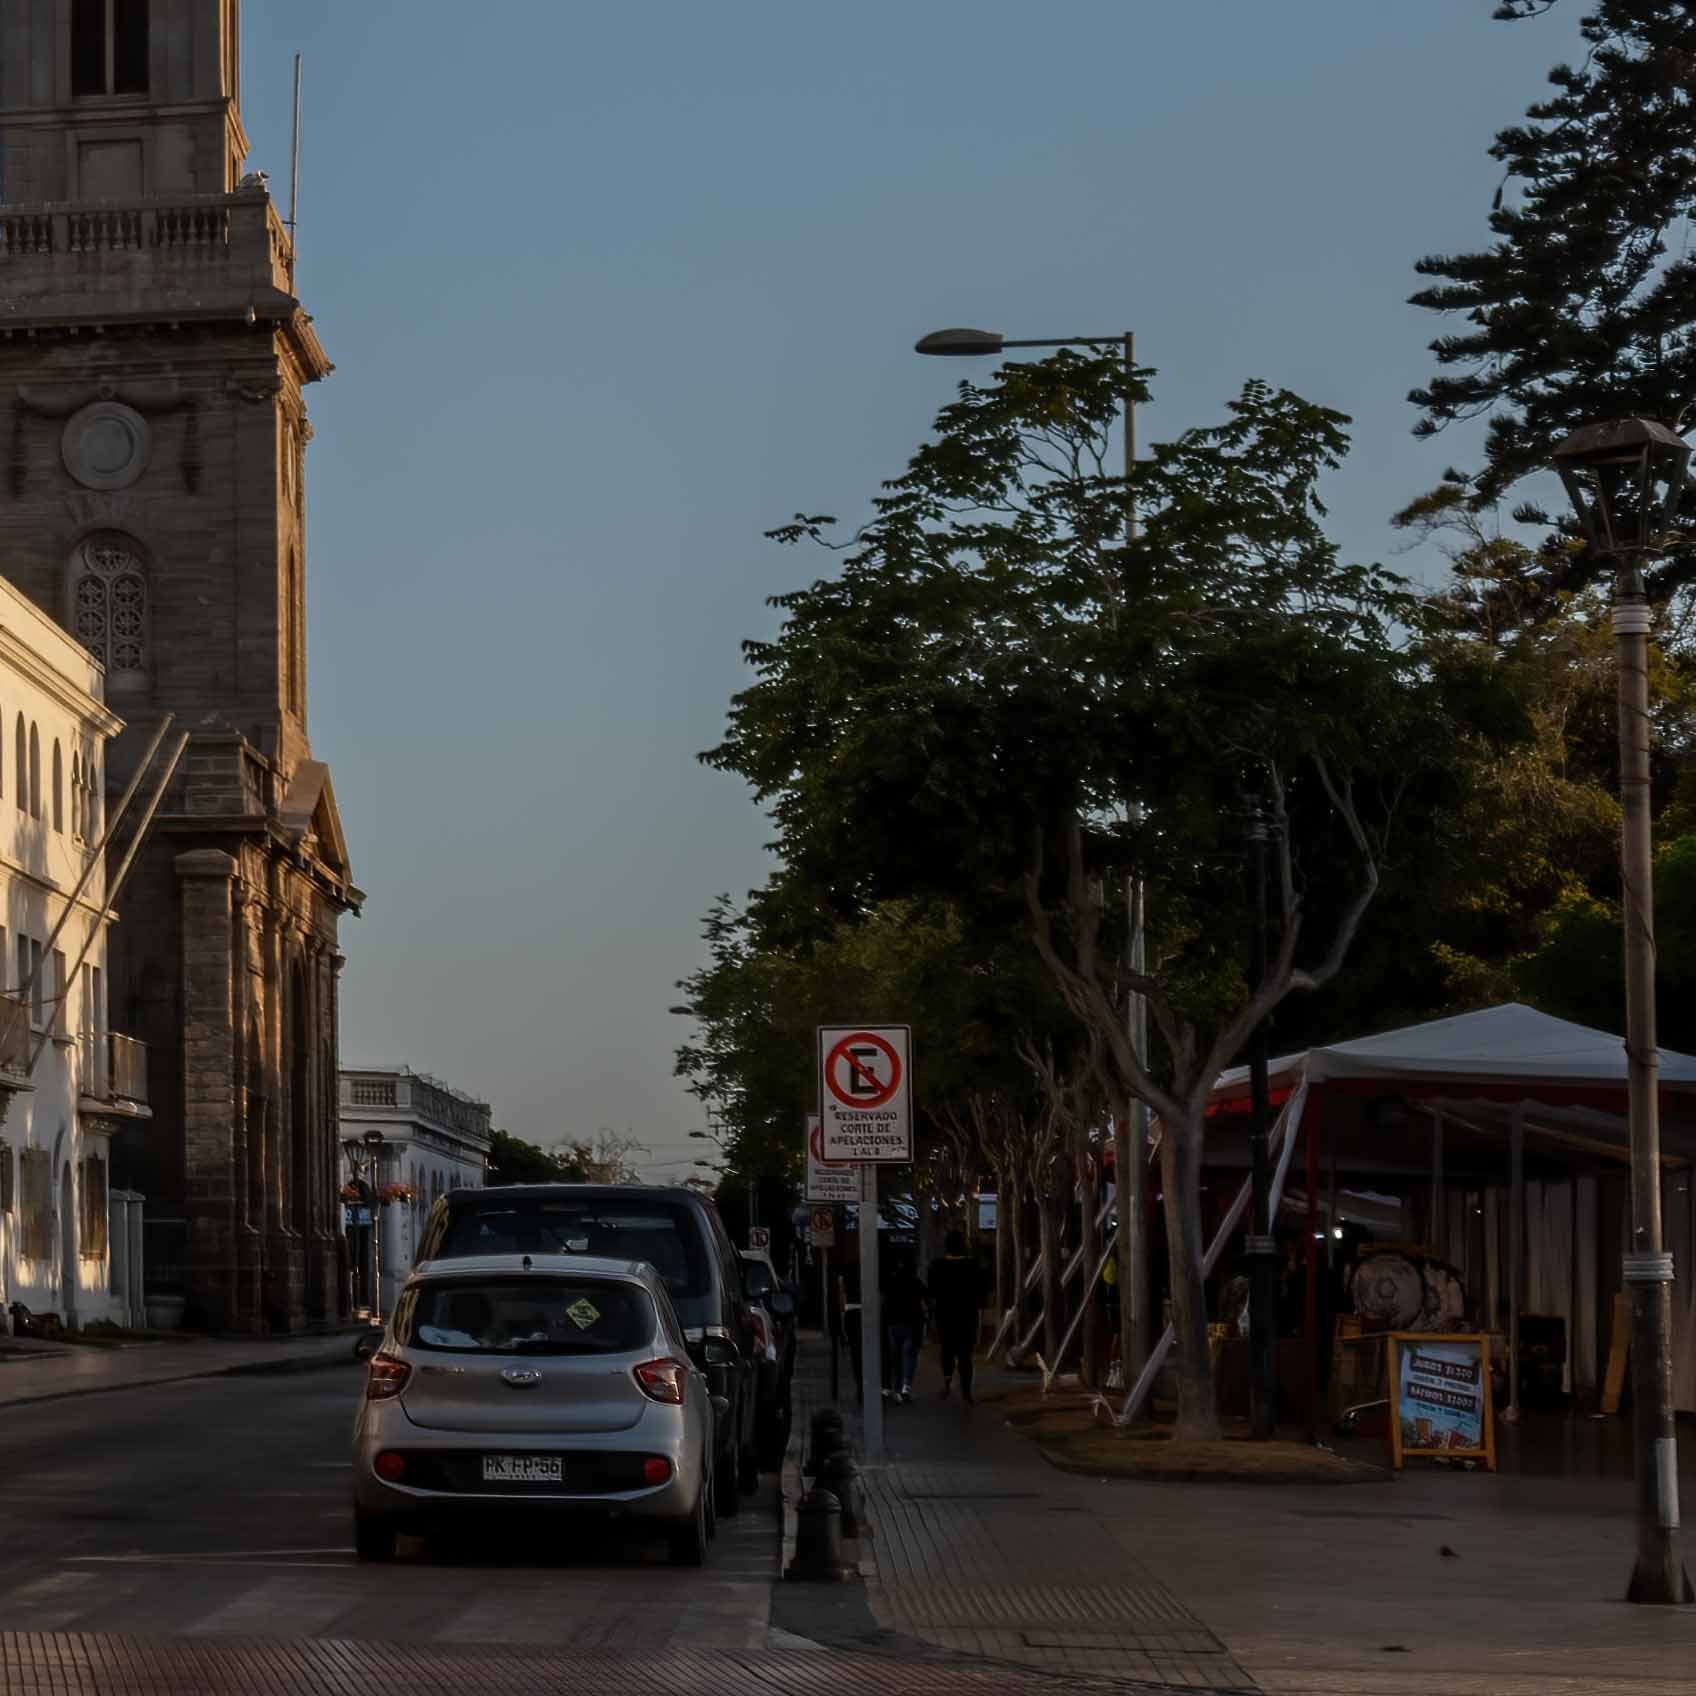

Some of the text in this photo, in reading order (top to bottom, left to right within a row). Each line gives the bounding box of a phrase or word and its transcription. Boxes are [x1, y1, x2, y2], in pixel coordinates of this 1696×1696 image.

[834, 1111, 897, 1121] RESERVADO
[840, 1123, 890, 1134] CORTE DE
[830, 1135, 904, 1146] APELACIONES
